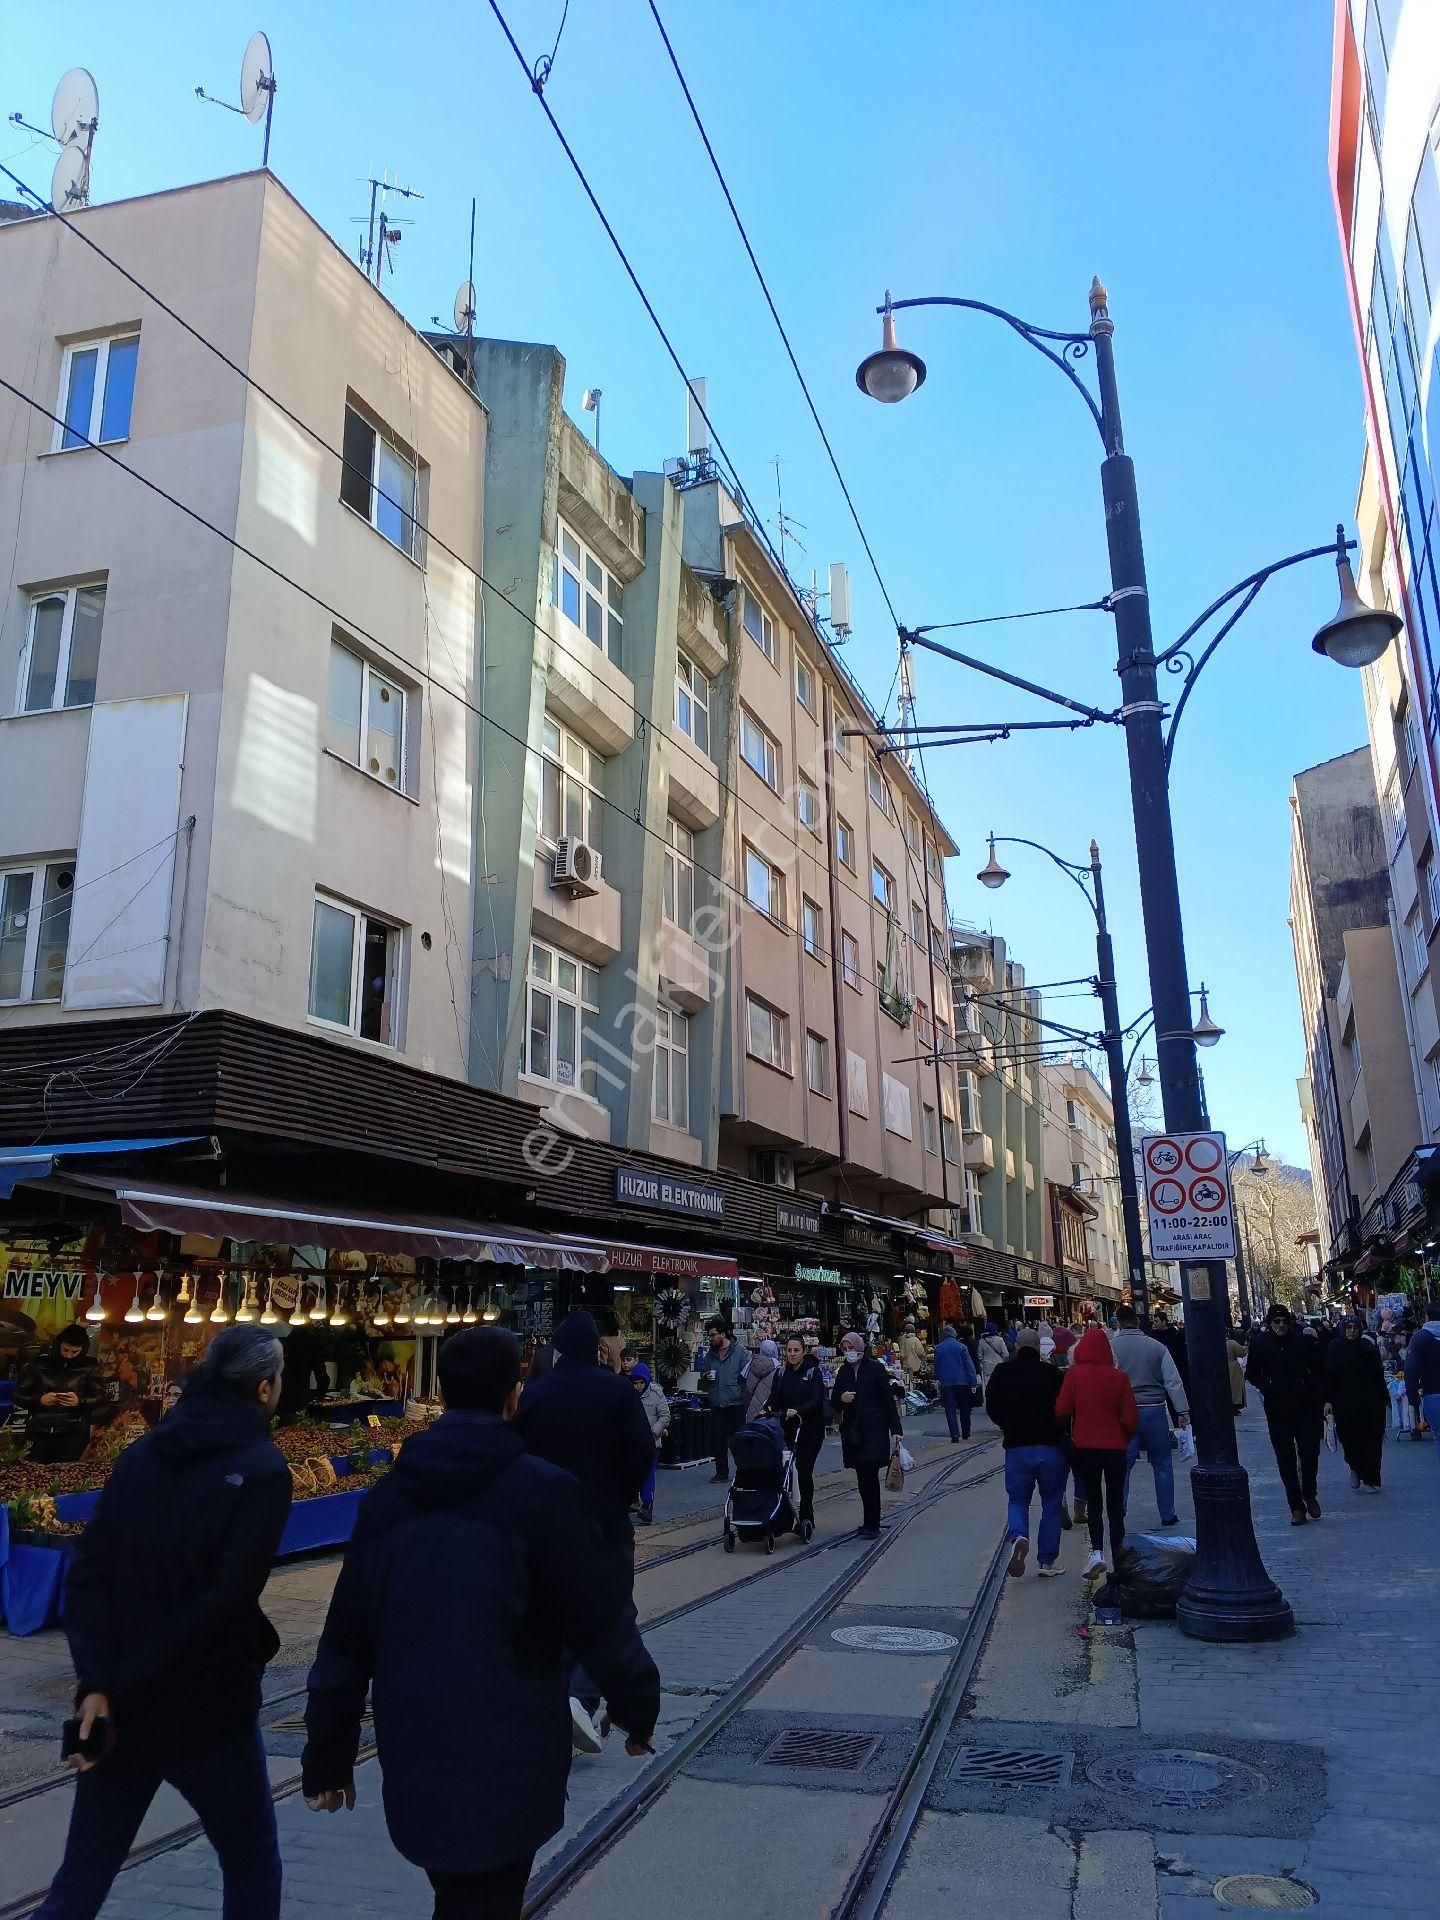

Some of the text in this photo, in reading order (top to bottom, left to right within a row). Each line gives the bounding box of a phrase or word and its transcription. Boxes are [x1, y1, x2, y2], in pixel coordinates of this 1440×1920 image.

[620, 1175, 724, 1214] HUZUR ELEKTRONİK
[1153, 1215, 1228, 1229] 11:00-22:00
[1192, 1242, 1229, 1251] KAPALIDIR
[611, 1250, 698, 1272] HUZUR ELEKTRONİK
